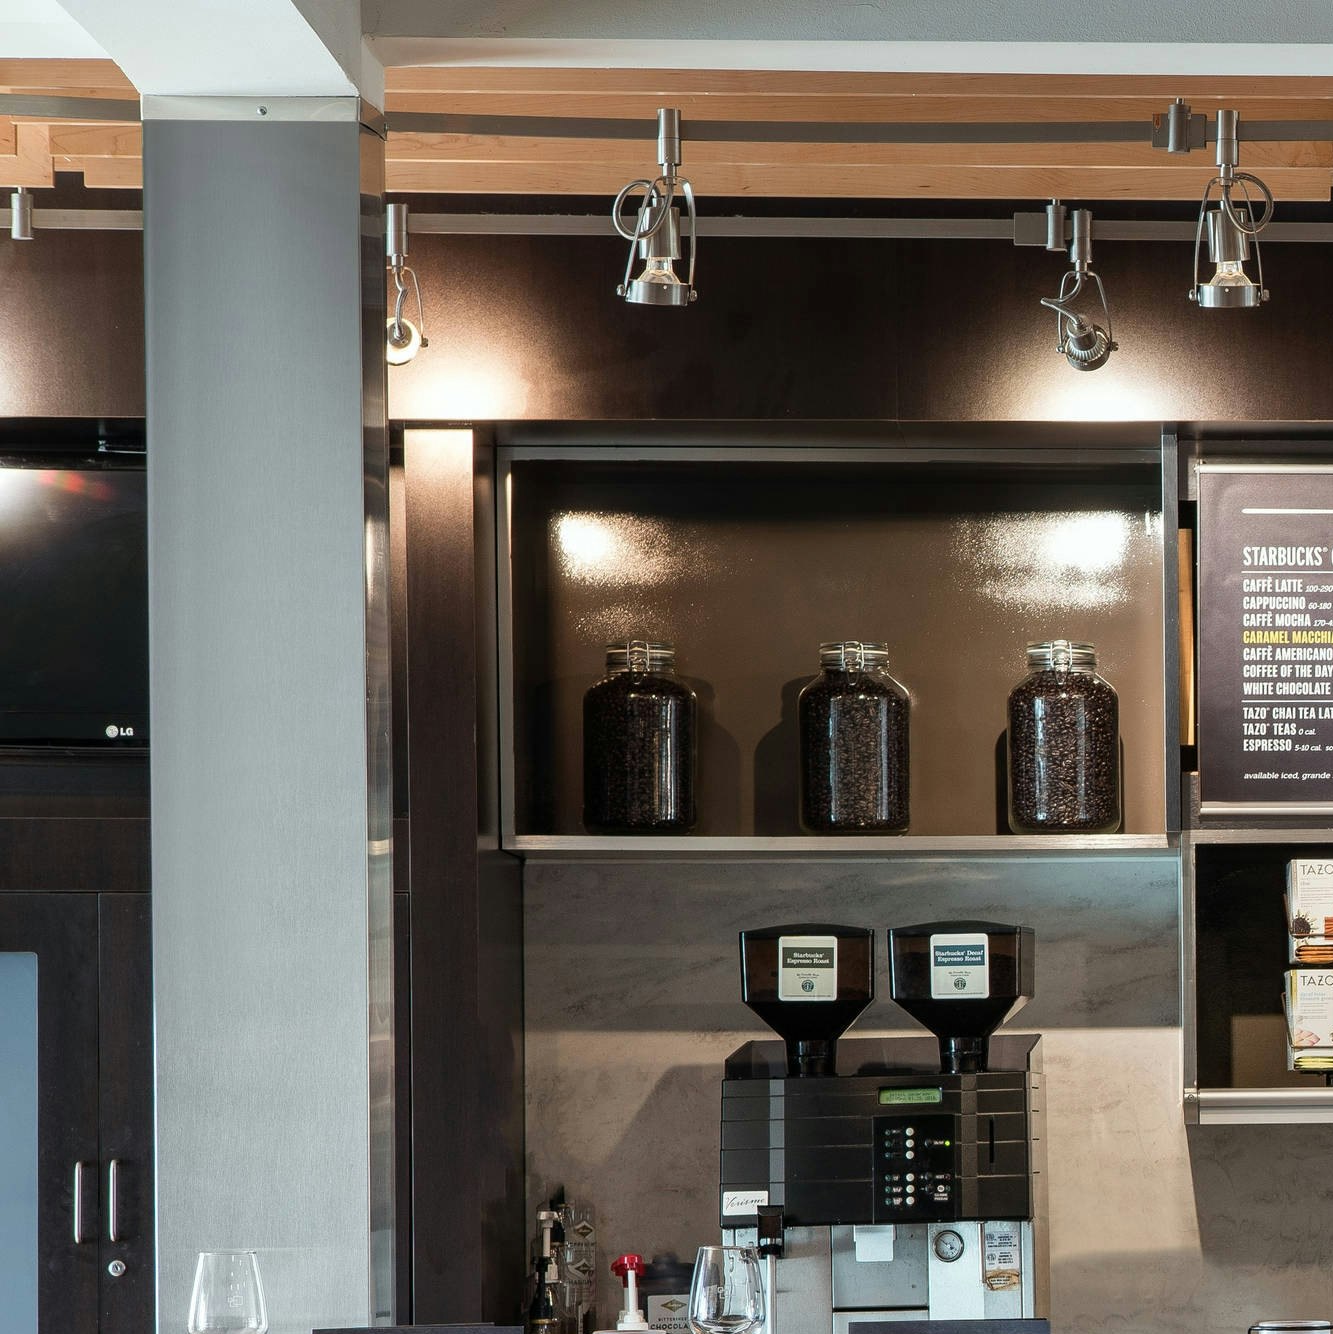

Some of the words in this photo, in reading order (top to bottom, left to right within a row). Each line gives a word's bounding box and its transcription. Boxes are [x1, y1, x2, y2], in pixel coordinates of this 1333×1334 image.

[1275, 579, 1303, 592] LATTE
[1243, 597, 1305, 609] CAPPUCCINO
[1243, 631, 1290, 643] CARAMEL
[1243, 665, 1278, 677] COFFEE
[1281, 665, 1292, 677] OF
[1295, 665, 1312, 677] THE
[1315, 665, 1333, 677] DAY
[1243, 682, 1273, 695] WHITE
[1276, 682, 1330, 695] CHOCOLATE
[120, 728, 133, 736] LG
[1244, 739, 1292, 751] ESPRESSO
[1300, 864, 1333, 875] TAZO
